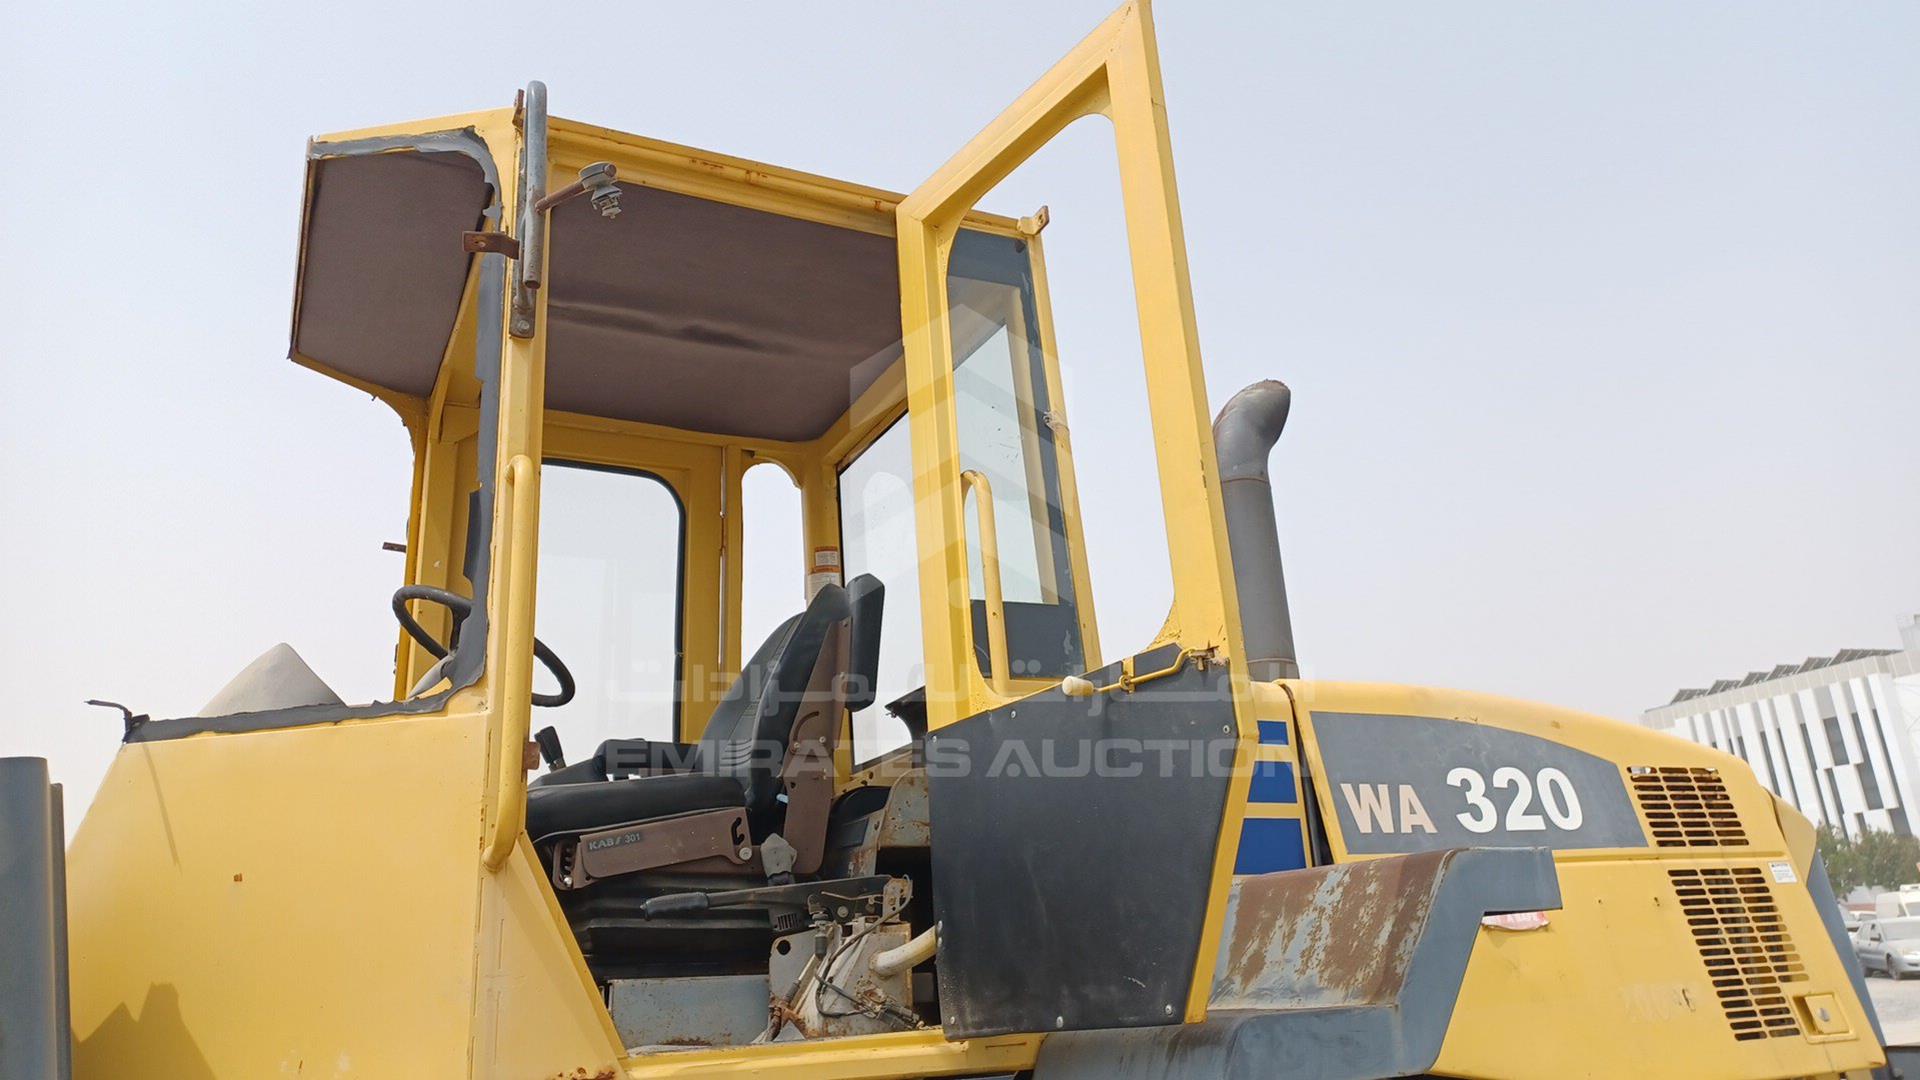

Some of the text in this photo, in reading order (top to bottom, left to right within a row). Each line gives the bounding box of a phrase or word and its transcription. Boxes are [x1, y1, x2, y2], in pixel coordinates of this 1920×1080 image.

[1340, 766, 1583, 834] WA 320
[624, 832, 641, 843] 301
